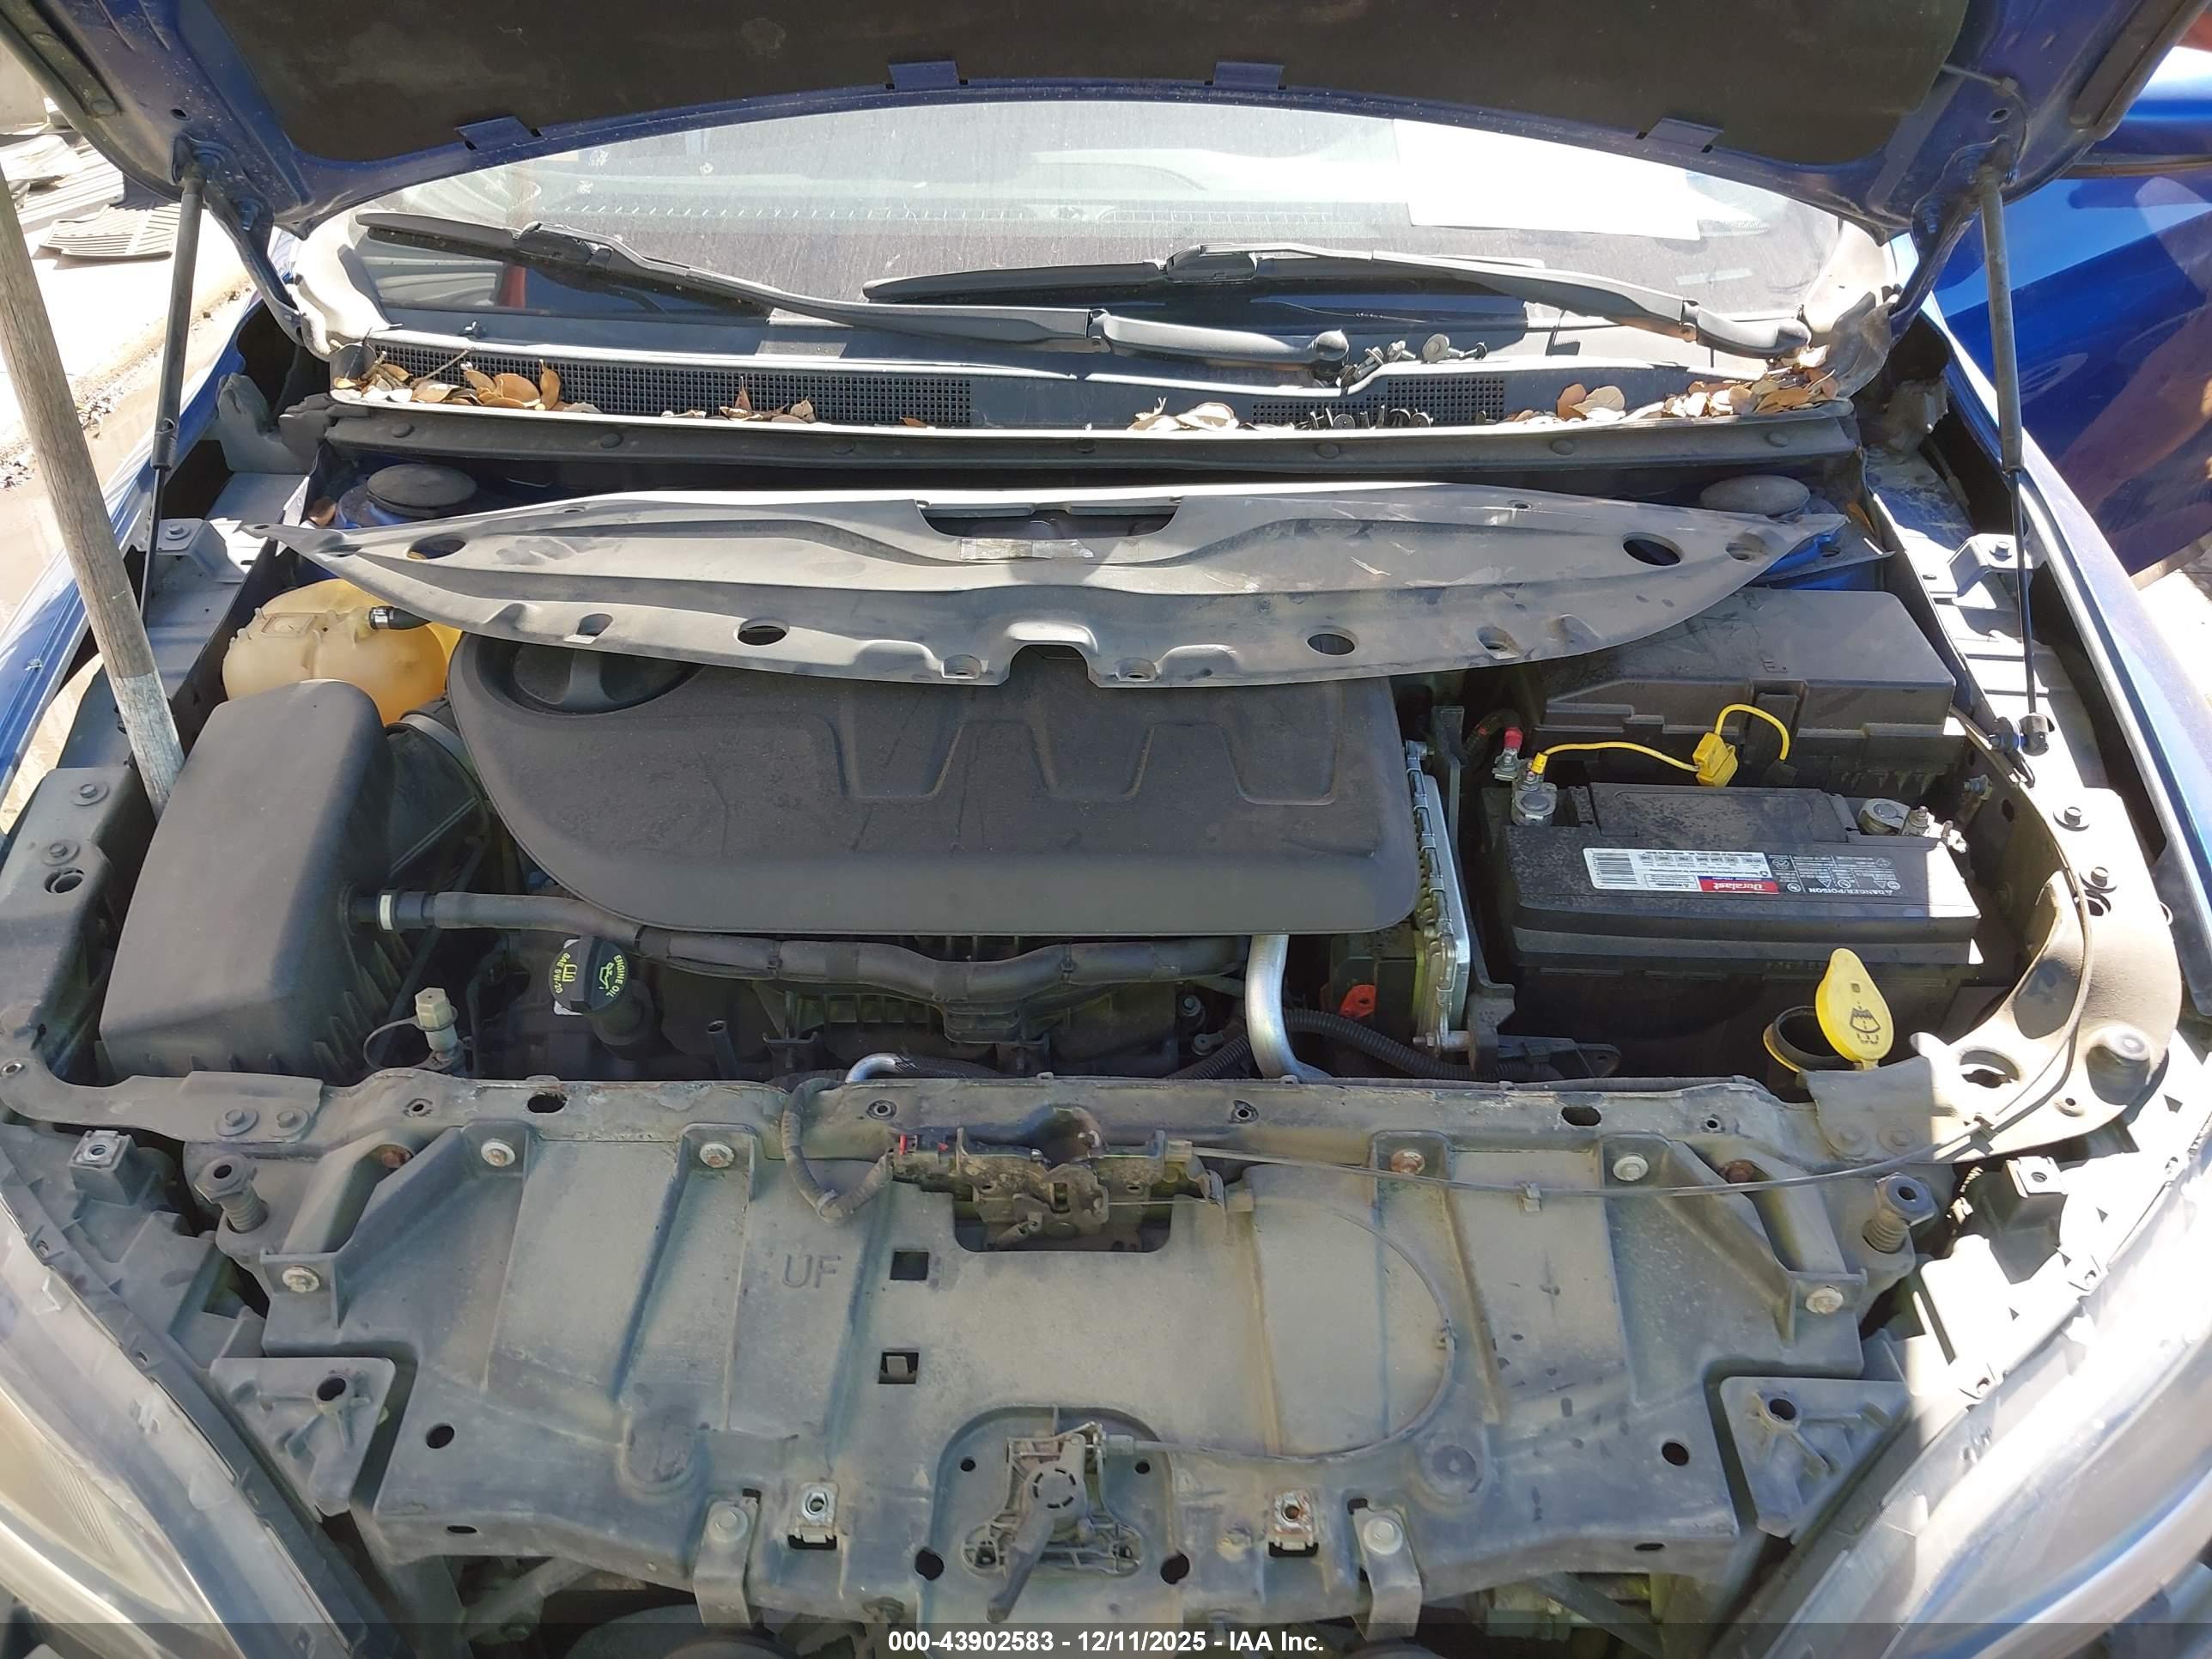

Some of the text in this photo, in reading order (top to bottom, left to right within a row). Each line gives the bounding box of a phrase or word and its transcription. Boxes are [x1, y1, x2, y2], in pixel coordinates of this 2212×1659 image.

[1713, 882, 1766, 891] Duralast
[605, 954, 626, 998] ENGINE OIL
[781, 1253, 842, 1289] UF
